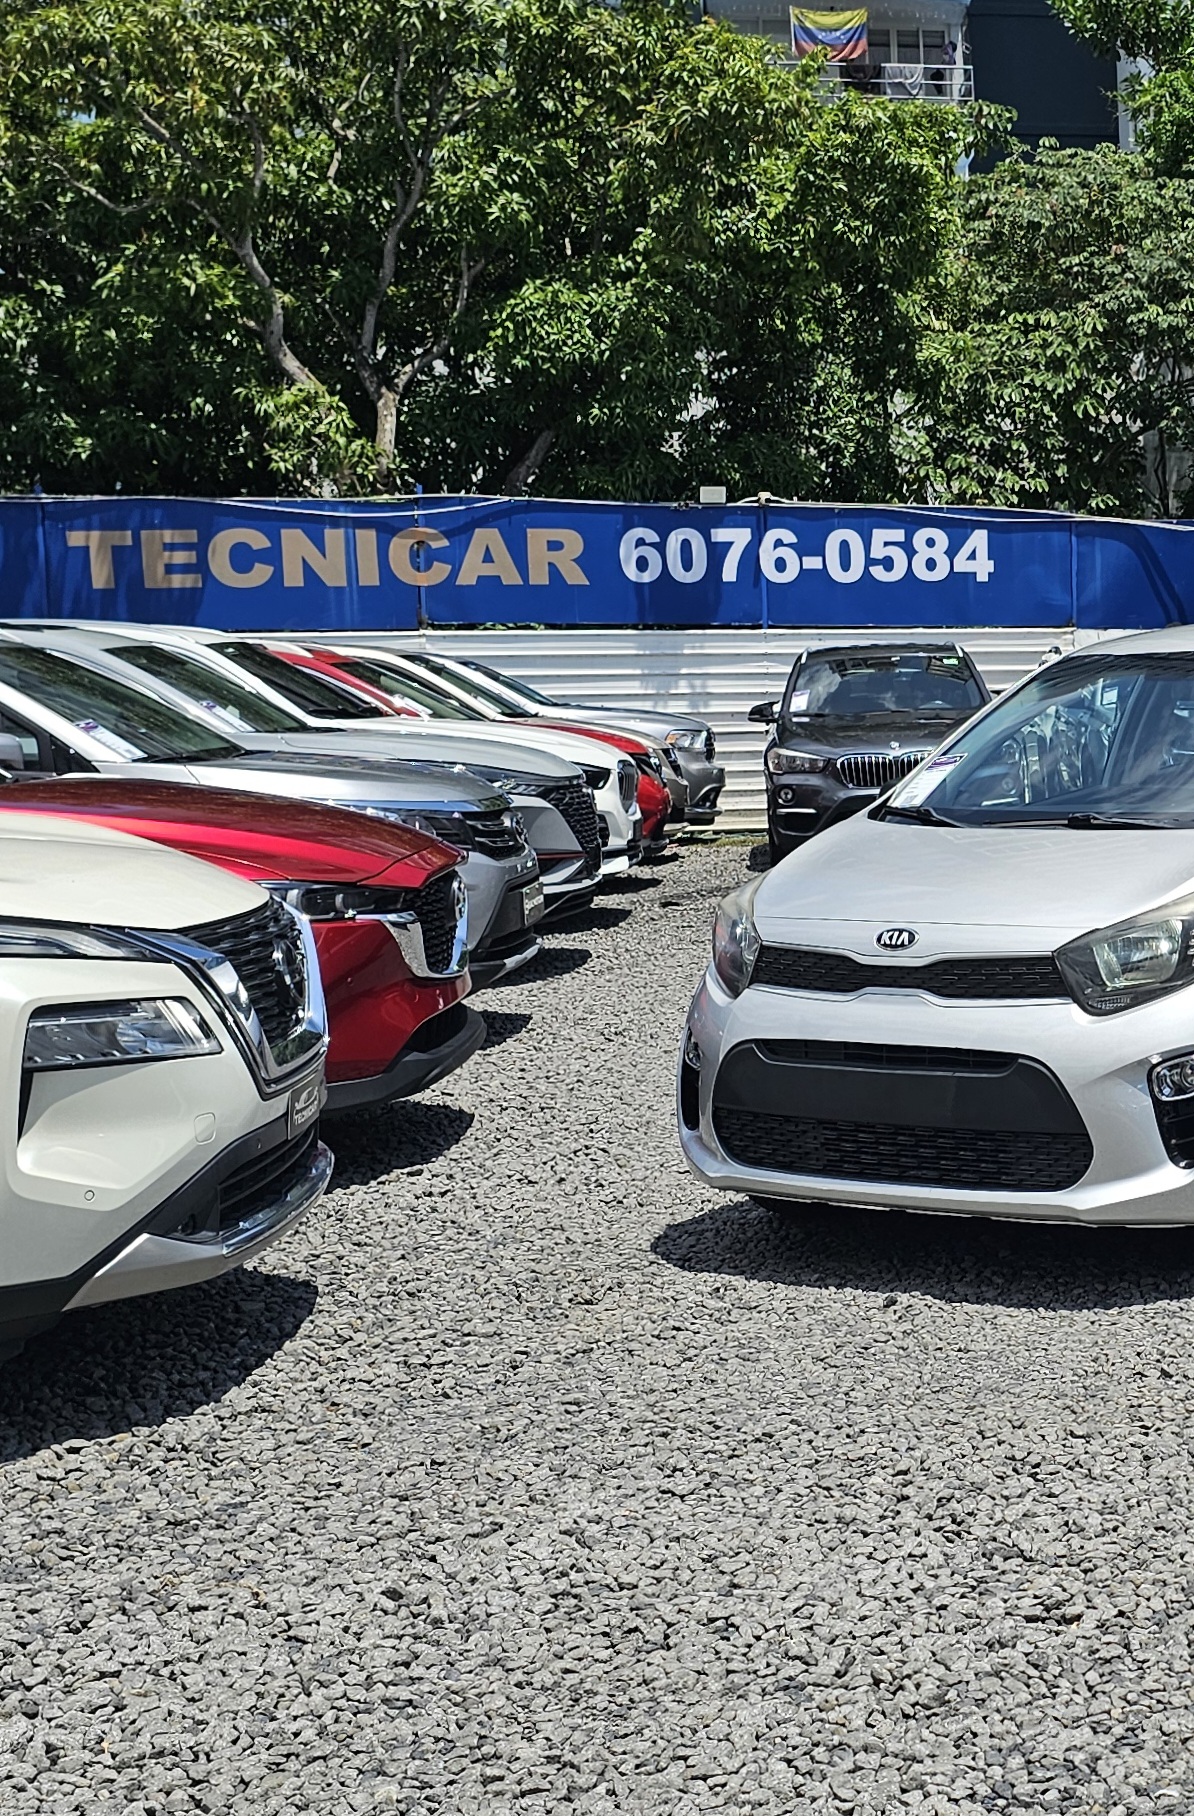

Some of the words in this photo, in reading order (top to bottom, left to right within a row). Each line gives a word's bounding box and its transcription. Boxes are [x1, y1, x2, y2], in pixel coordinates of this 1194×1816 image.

[66, 526, 590, 590] TECNICAR
[619, 527, 995, 584] 6076-0584
[880, 931, 909, 946] KIA
